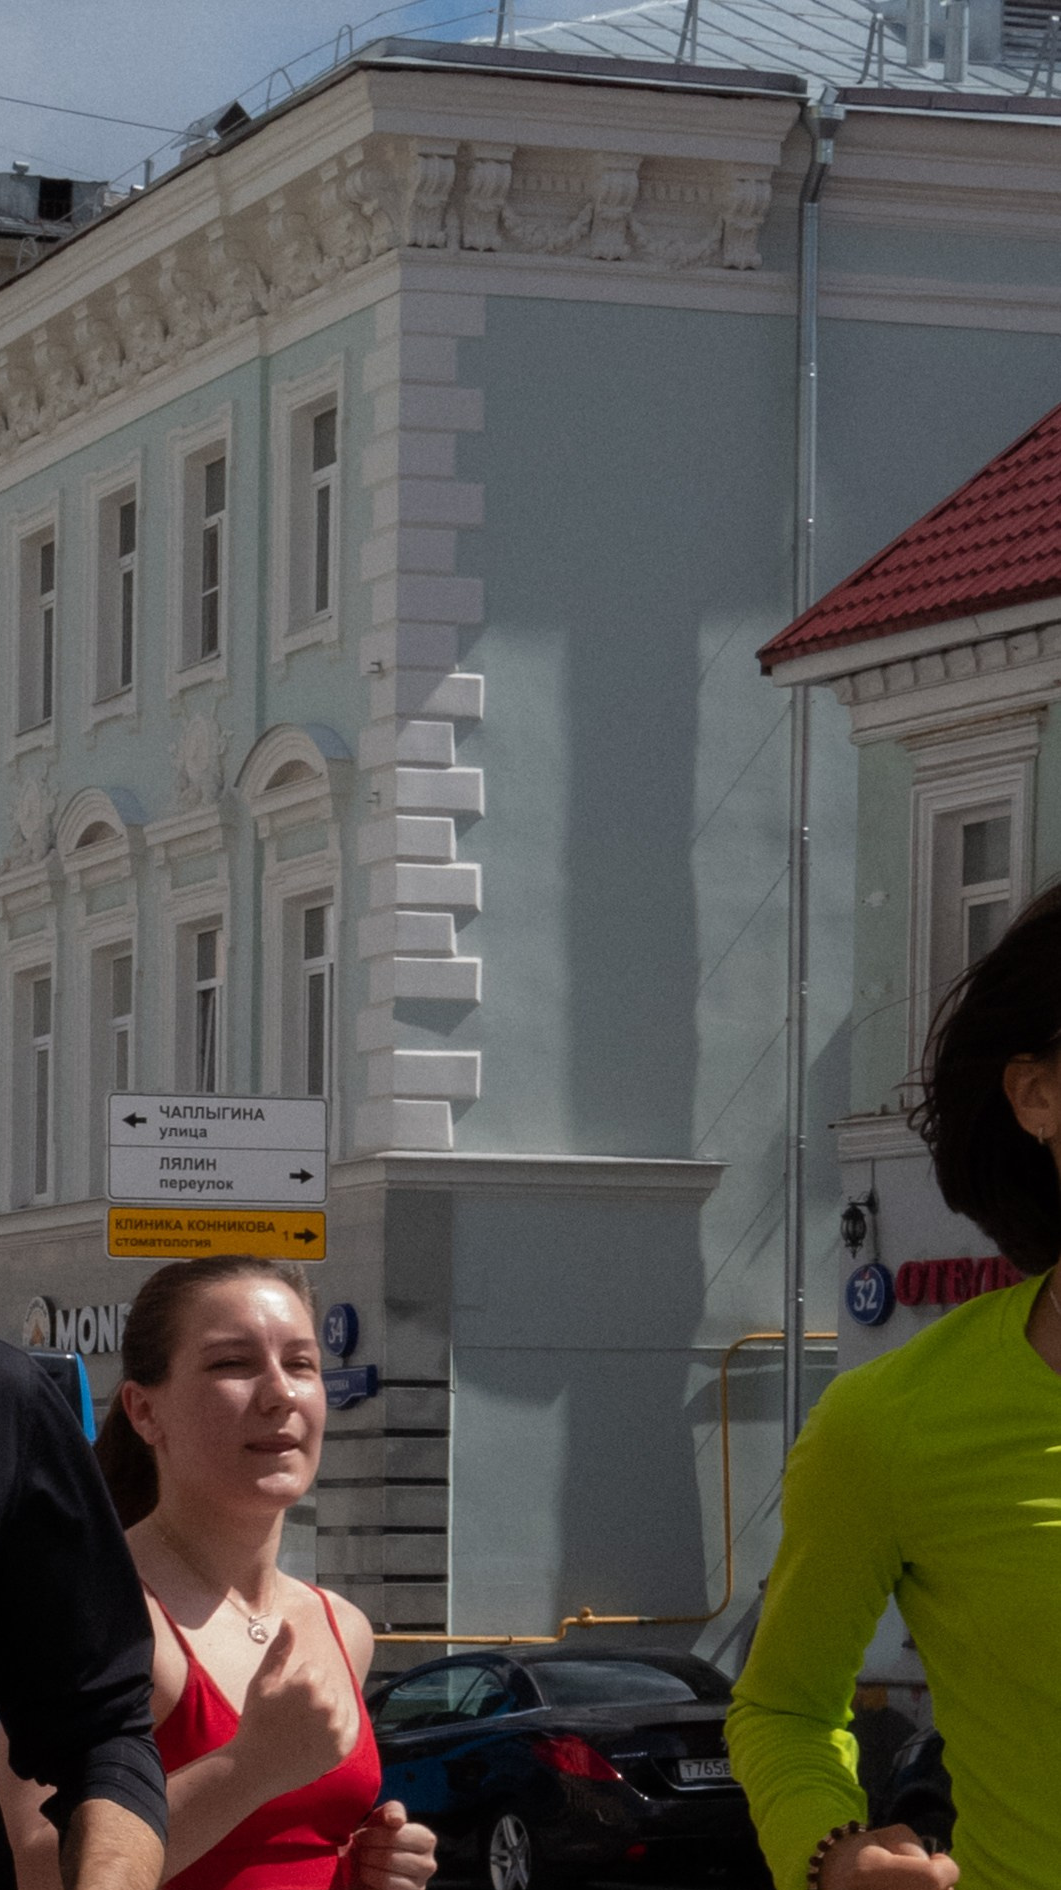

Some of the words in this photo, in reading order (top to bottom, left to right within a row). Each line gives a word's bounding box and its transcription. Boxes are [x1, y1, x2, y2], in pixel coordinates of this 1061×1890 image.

[159, 1105, 265, 1121] ЧАПЛЫГИНА
[159, 1127, 207, 1140] улица
[159, 1157, 217, 1171] ЛЯЛИН
[159, 1179, 234, 1192] переулок
[115, 1219, 183, 1231] КЛИНИКА
[187, 1219, 276, 1233] КОННИКОВА
[115, 1237, 211, 1248] стоматология
[854, 1278, 877, 1312] 32
[328, 1317, 343, 1344] 34
